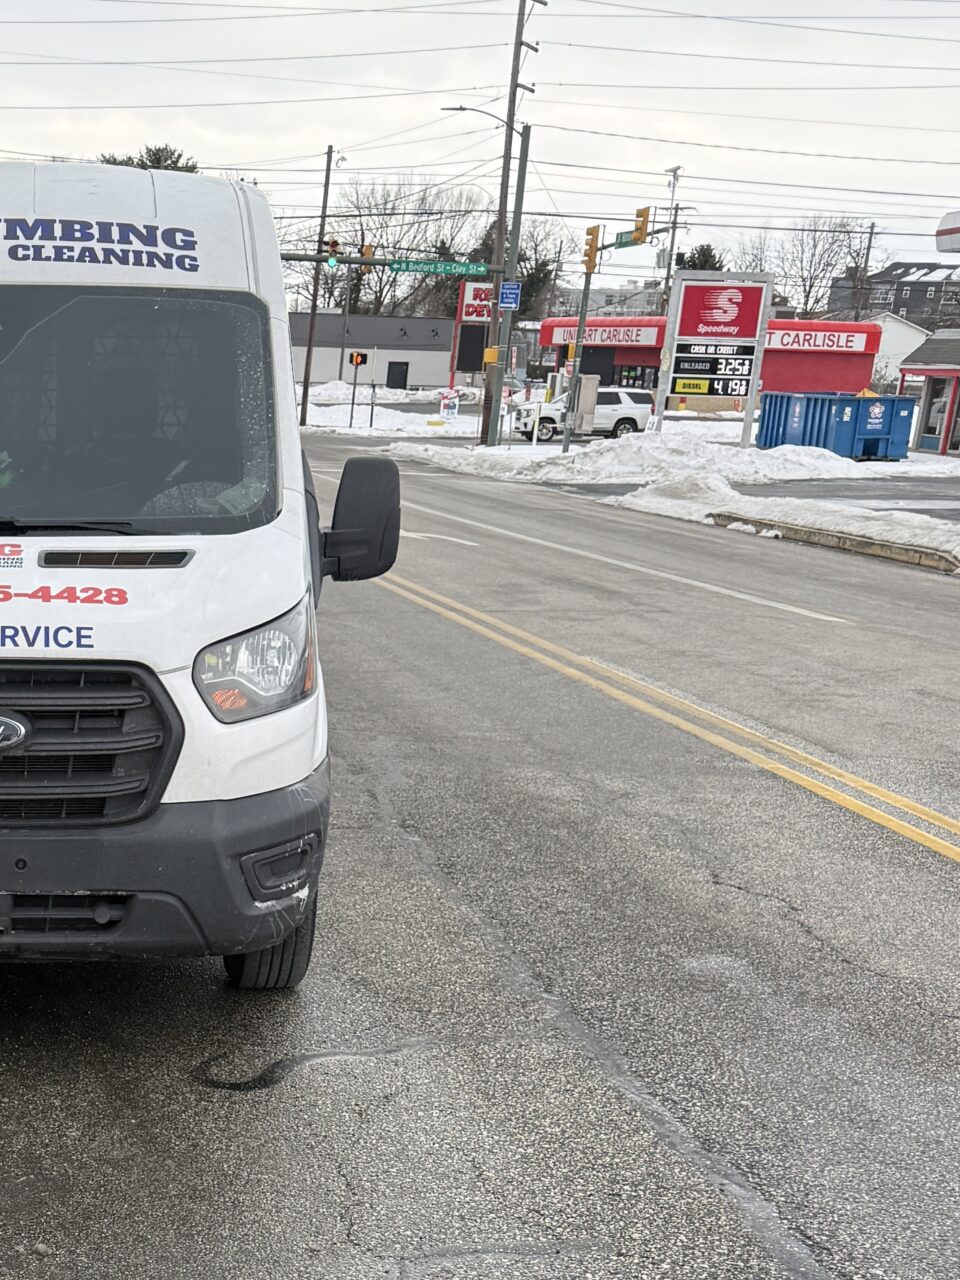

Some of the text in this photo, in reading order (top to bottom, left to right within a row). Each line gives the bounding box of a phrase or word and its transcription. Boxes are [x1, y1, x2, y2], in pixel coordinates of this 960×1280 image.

[8, 244, 200, 272] CLEANING
[400, 262, 406, 270] N
[408, 262, 434, 271] Bedford
[437, 264, 445, 272] St
[451, 264, 466, 273] Clay
[469, 265, 477, 273] St
[473, 287, 493, 302] RE
[697, 323, 740, 335] Speedway
[562, 329, 642, 343] UNIART CARLISLE
[781, 332, 855, 349] CARLISLE
[690, 345, 738, 354] CASH OR CREDIT
[680, 361, 710, 370] UNLEADED
[682, 382, 701, 390] DIESEL
